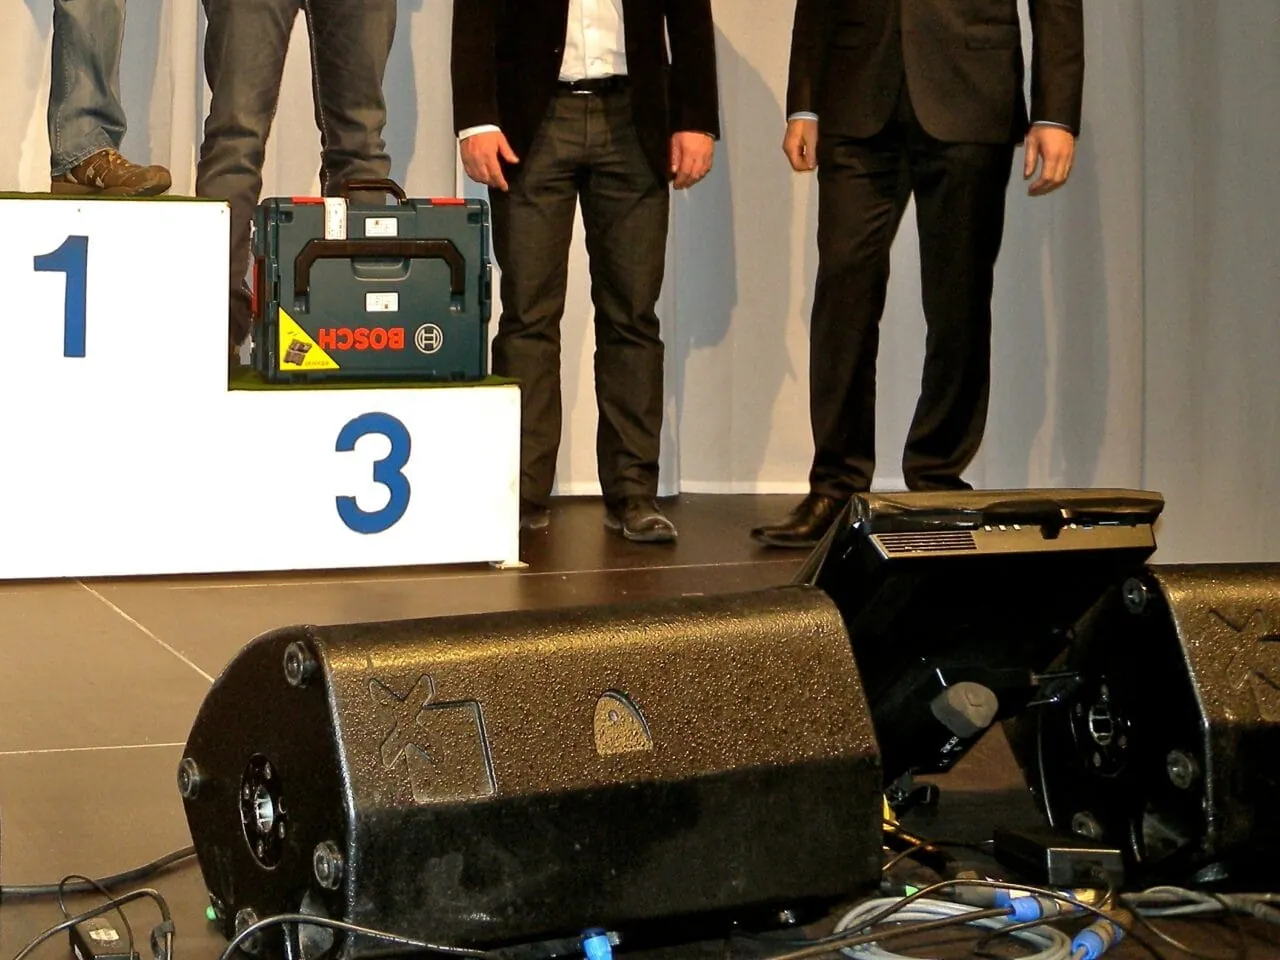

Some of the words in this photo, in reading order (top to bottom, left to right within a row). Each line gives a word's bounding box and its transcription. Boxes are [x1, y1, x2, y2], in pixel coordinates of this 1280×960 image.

[33, 234, 89, 358] 1
[319, 327, 404, 351] BOSCH
[335, 411, 412, 536] 3
